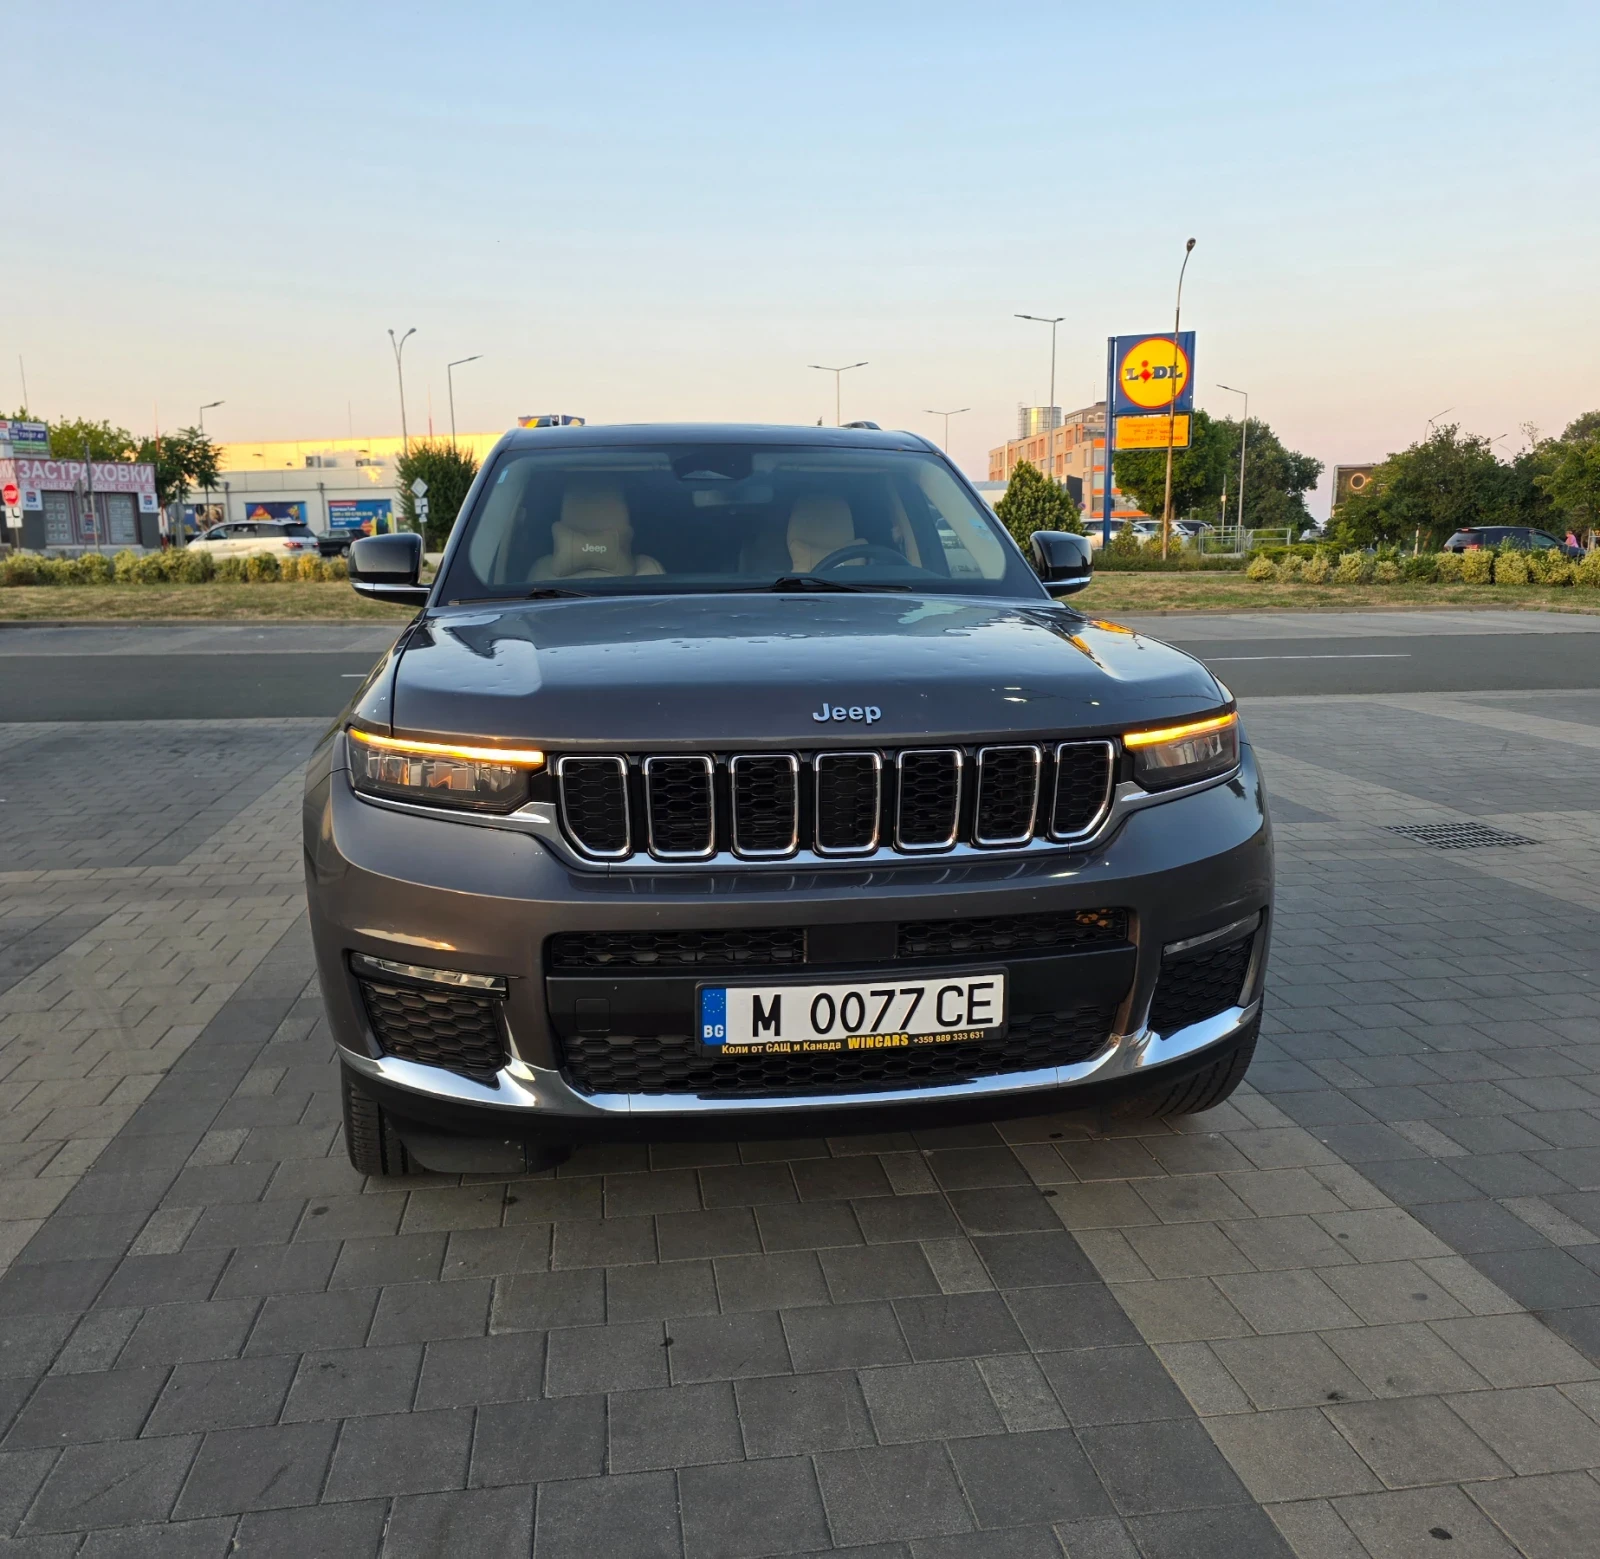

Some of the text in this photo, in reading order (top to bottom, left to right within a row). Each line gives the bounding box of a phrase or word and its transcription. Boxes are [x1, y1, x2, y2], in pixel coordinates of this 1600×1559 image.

[19, 460, 152, 482] ЗАСТРАХОВКИ
[33, 481, 76, 490] GENERA
[582, 543, 607, 555] Jeep
[812, 703, 882, 724] Jeep
[752, 982, 994, 1037] M 0077 CE
[703, 1025, 724, 1038] BG
[722, 1044, 749, 1054] Коли
[751, 1045, 763, 1053] от
[766, 1042, 791, 1054] САЩ
[803, 1041, 842, 1052] Канада
[847, 1034, 909, 1049] WINCARS
[913, 1035, 934, 1044] +359
[935, 1034, 951, 1043] 889
[952, 1033, 969, 1041] 333
[969, 1031, 985, 1040] 631
